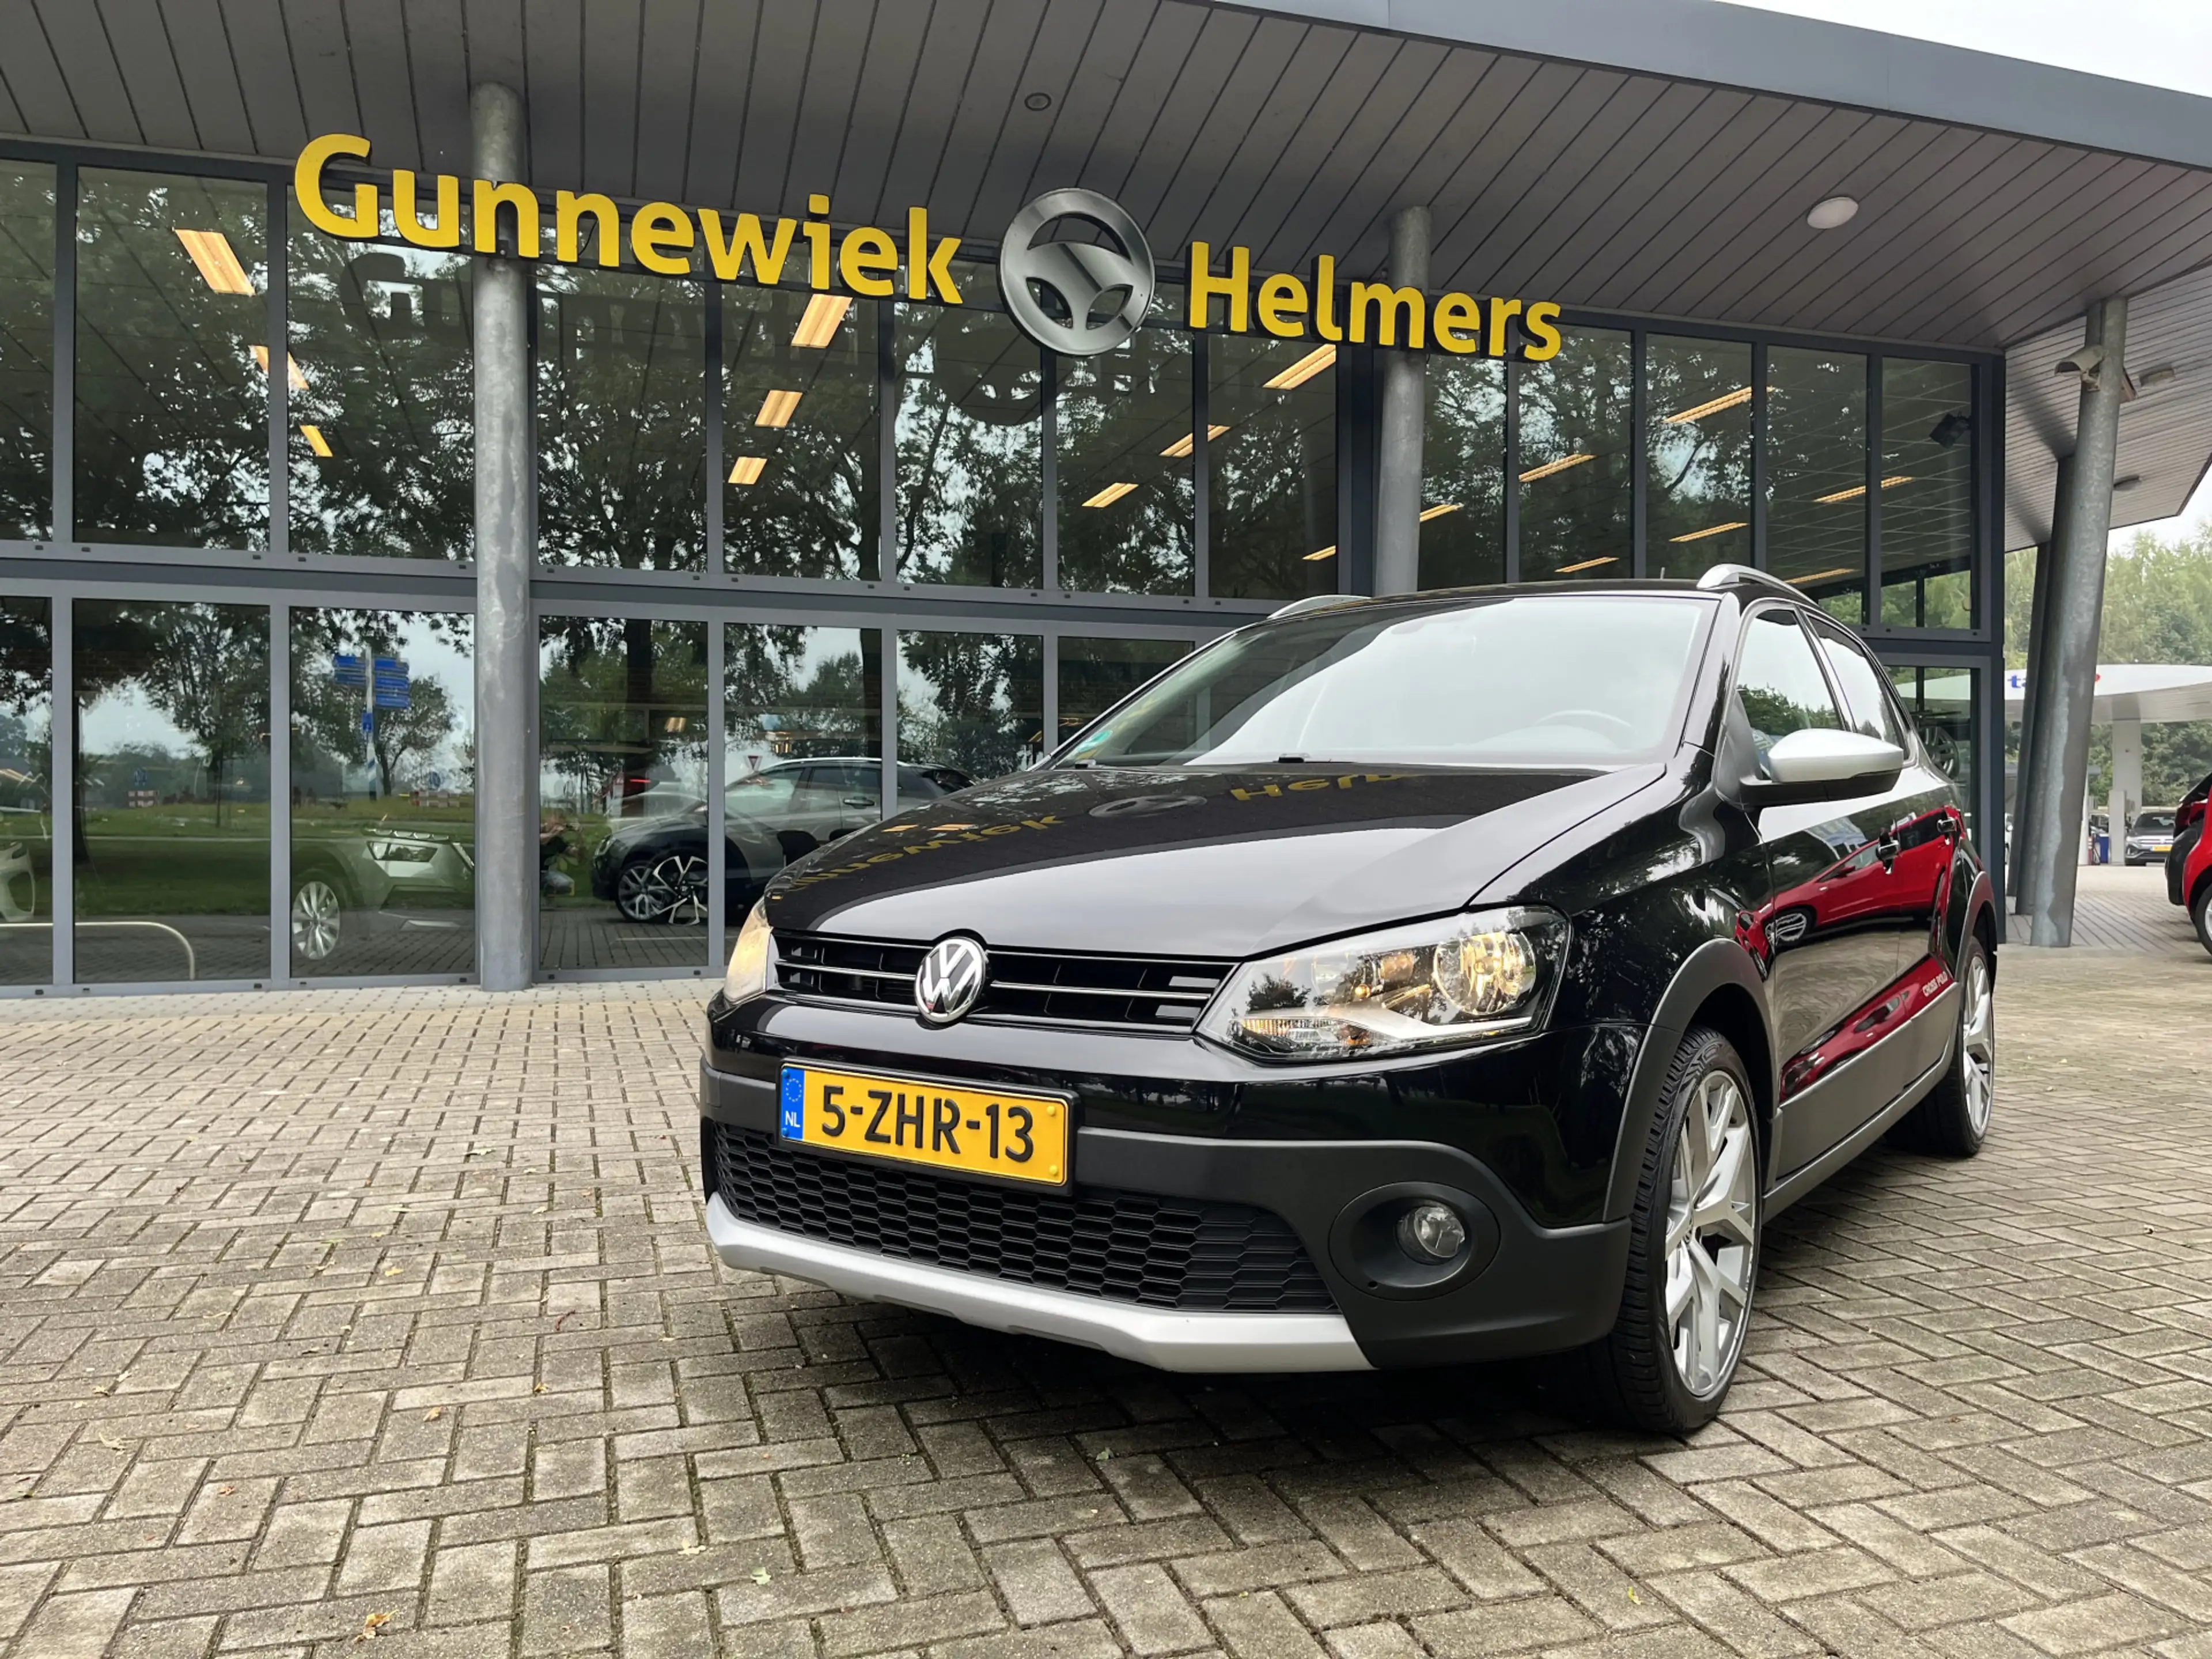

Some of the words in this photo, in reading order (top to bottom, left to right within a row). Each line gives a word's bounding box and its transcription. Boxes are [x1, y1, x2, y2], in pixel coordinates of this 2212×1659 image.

[294, 134, 963, 304] Gunnewiek
[1190, 241, 1562, 361] Helmers
[785, 1111, 801, 1127] NL
[822, 1085, 1034, 1162] 5-ZHR-13
